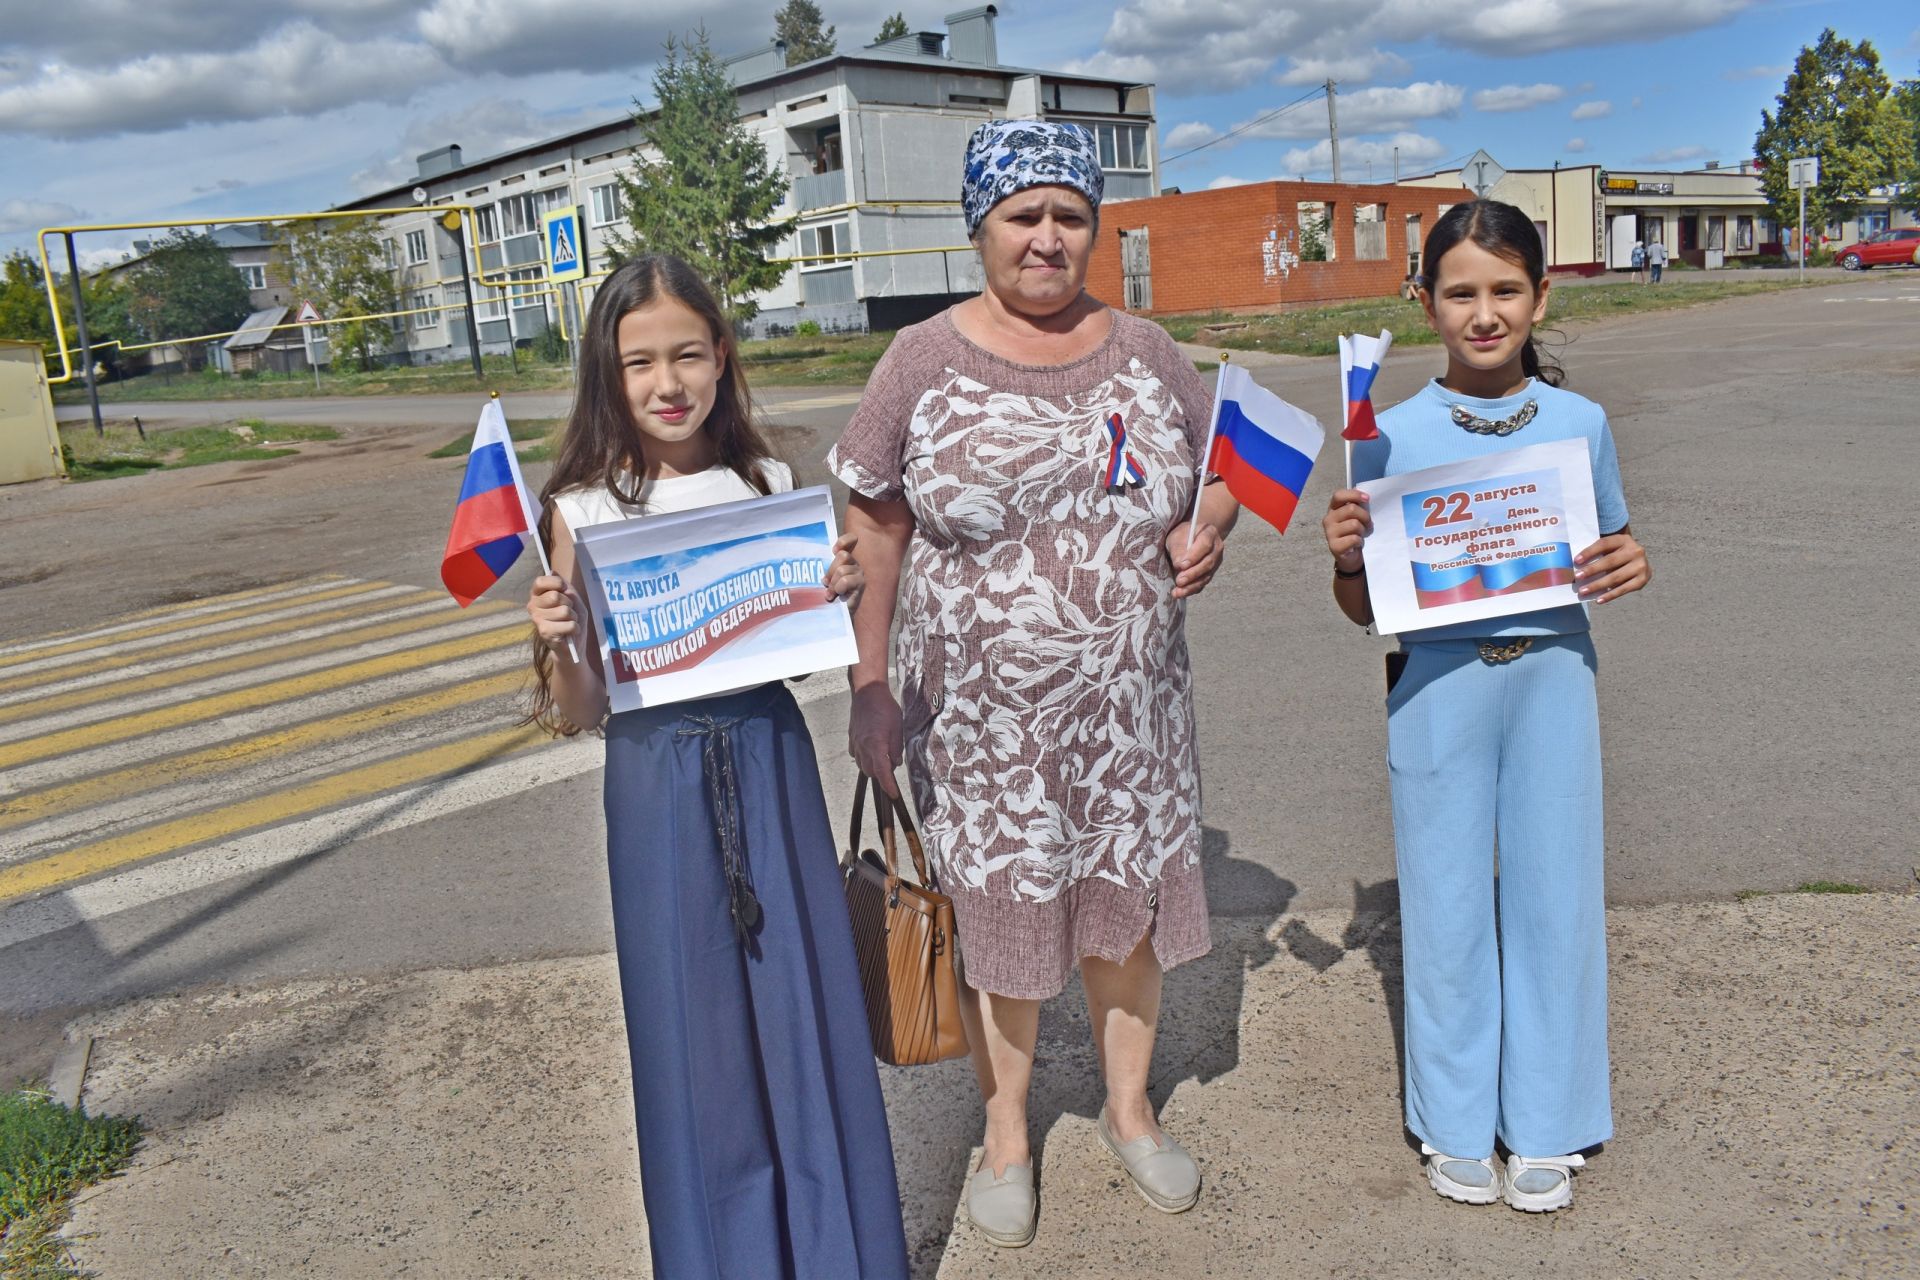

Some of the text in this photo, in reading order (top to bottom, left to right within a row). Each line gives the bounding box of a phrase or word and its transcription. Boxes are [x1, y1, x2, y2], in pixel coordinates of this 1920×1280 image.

[1422, 484, 1537, 527] 22 августа
[1507, 505, 1540, 519] День
[1415, 516, 1558, 548] Государственного
[1466, 537, 1516, 557] флага
[1431, 544, 1556, 571] Российской Федерации
[605, 571, 680, 601] 22 АВГУСТА
[615, 560, 825, 645] ДЕНЬ ГОСУДАРСТВЕННОГО ФЛАГА
[621, 589, 791, 673] РОССИЙСКОЙ ФЕДЕРАЦИИ
